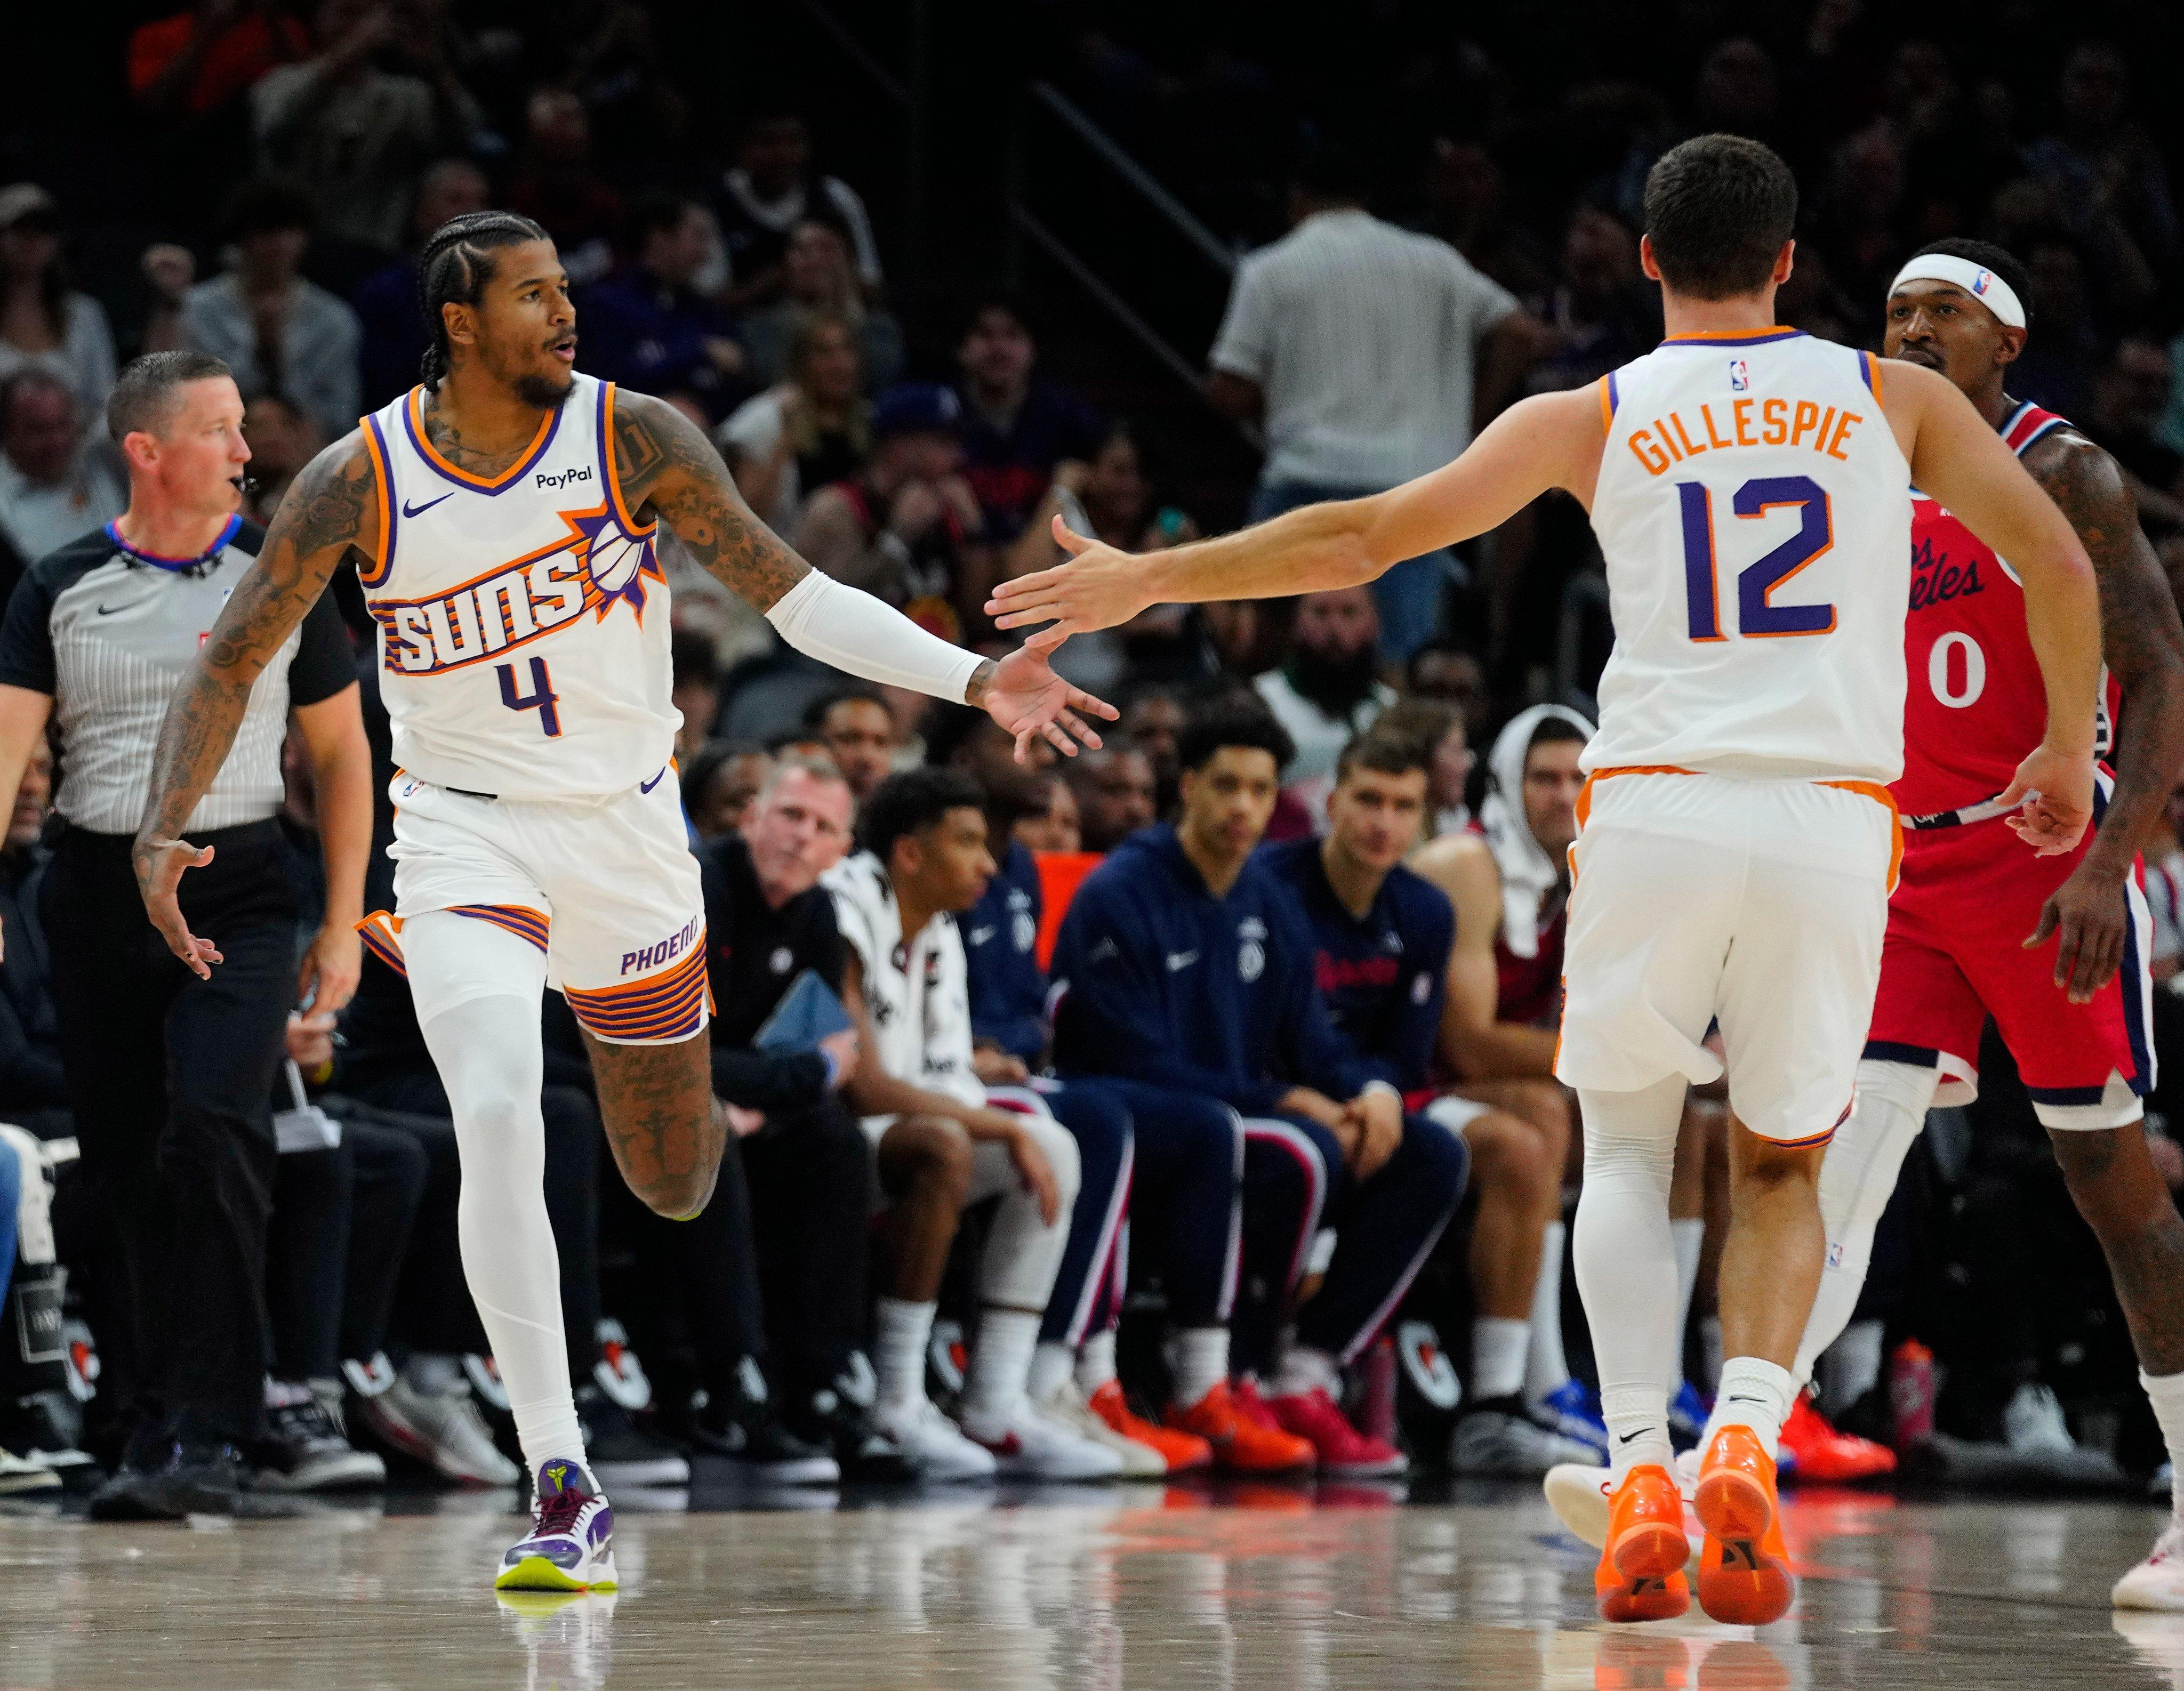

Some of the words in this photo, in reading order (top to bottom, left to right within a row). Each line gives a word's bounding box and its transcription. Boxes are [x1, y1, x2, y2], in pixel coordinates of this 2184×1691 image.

[1628, 398, 1863, 476] GILLESPIE
[536, 465, 592, 489] PayPal
[1675, 475, 1837, 642] 12
[1909, 552, 1987, 611] eles
[394, 549, 585, 671] SUNS
[493, 656, 563, 738] 4
[1928, 631, 1986, 709] 0
